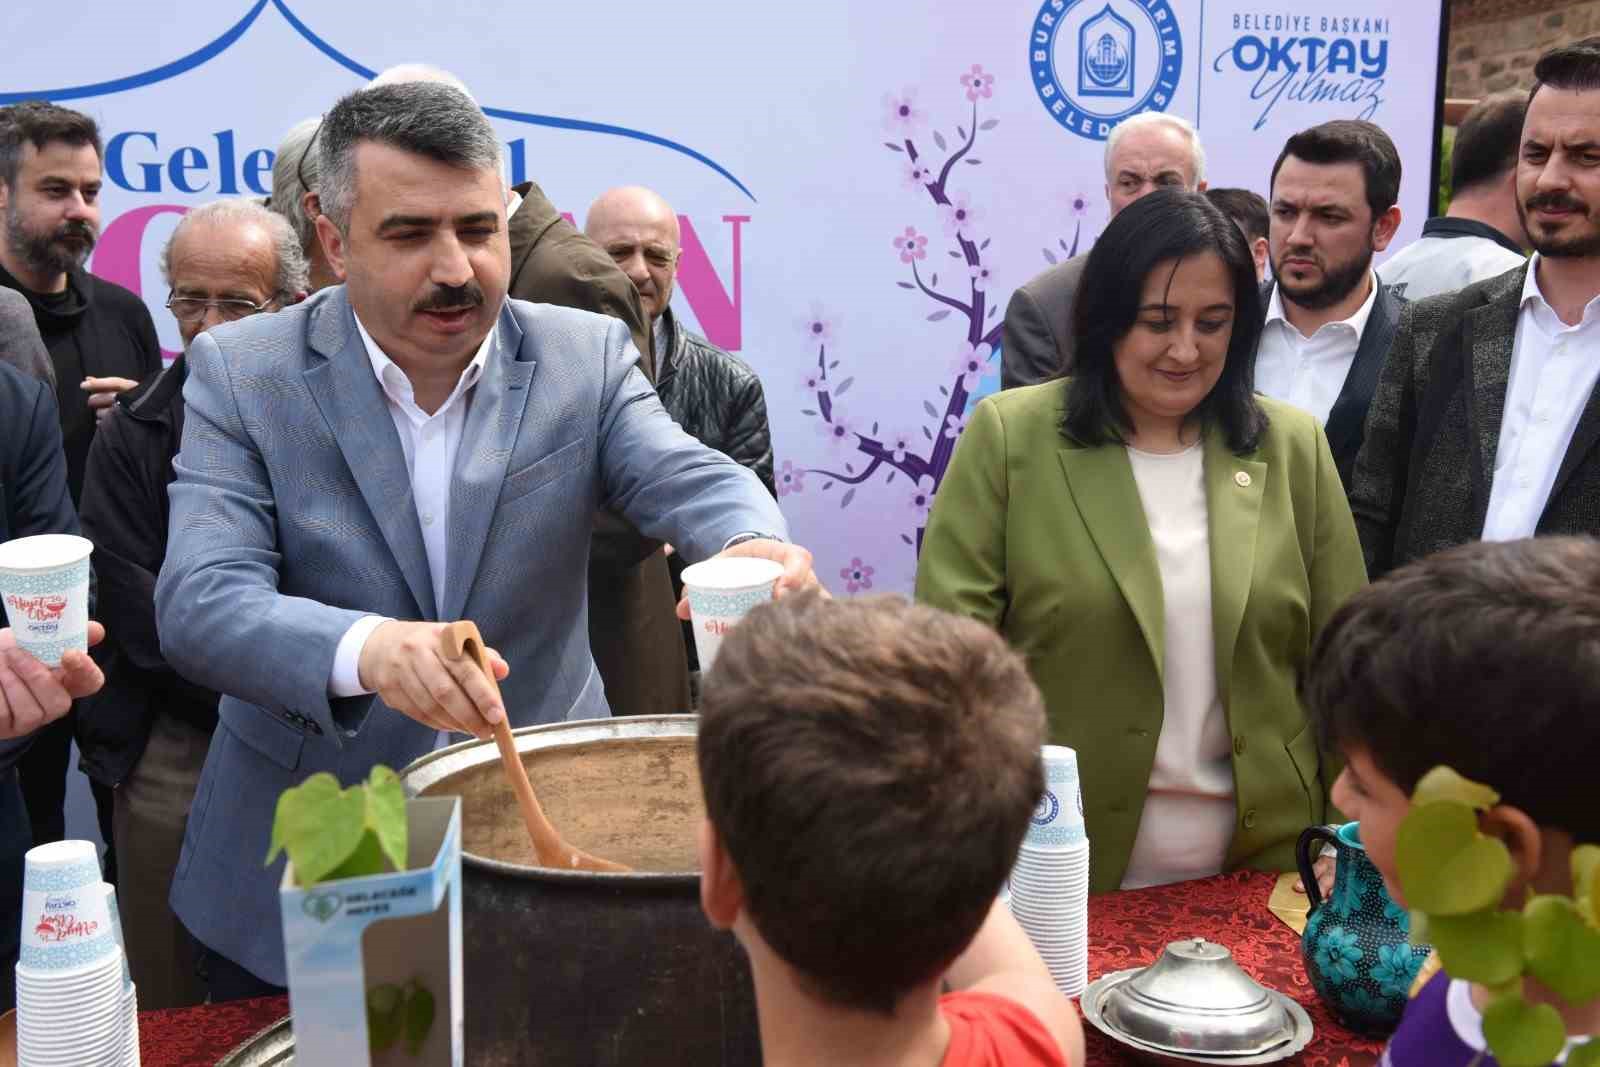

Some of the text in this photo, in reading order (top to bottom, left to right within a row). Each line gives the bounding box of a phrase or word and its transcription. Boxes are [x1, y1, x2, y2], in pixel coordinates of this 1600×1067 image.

[1232, 13, 1390, 35] BELEDİYE BAŞKANI
[1232, 34, 1389, 79] OKTAY
